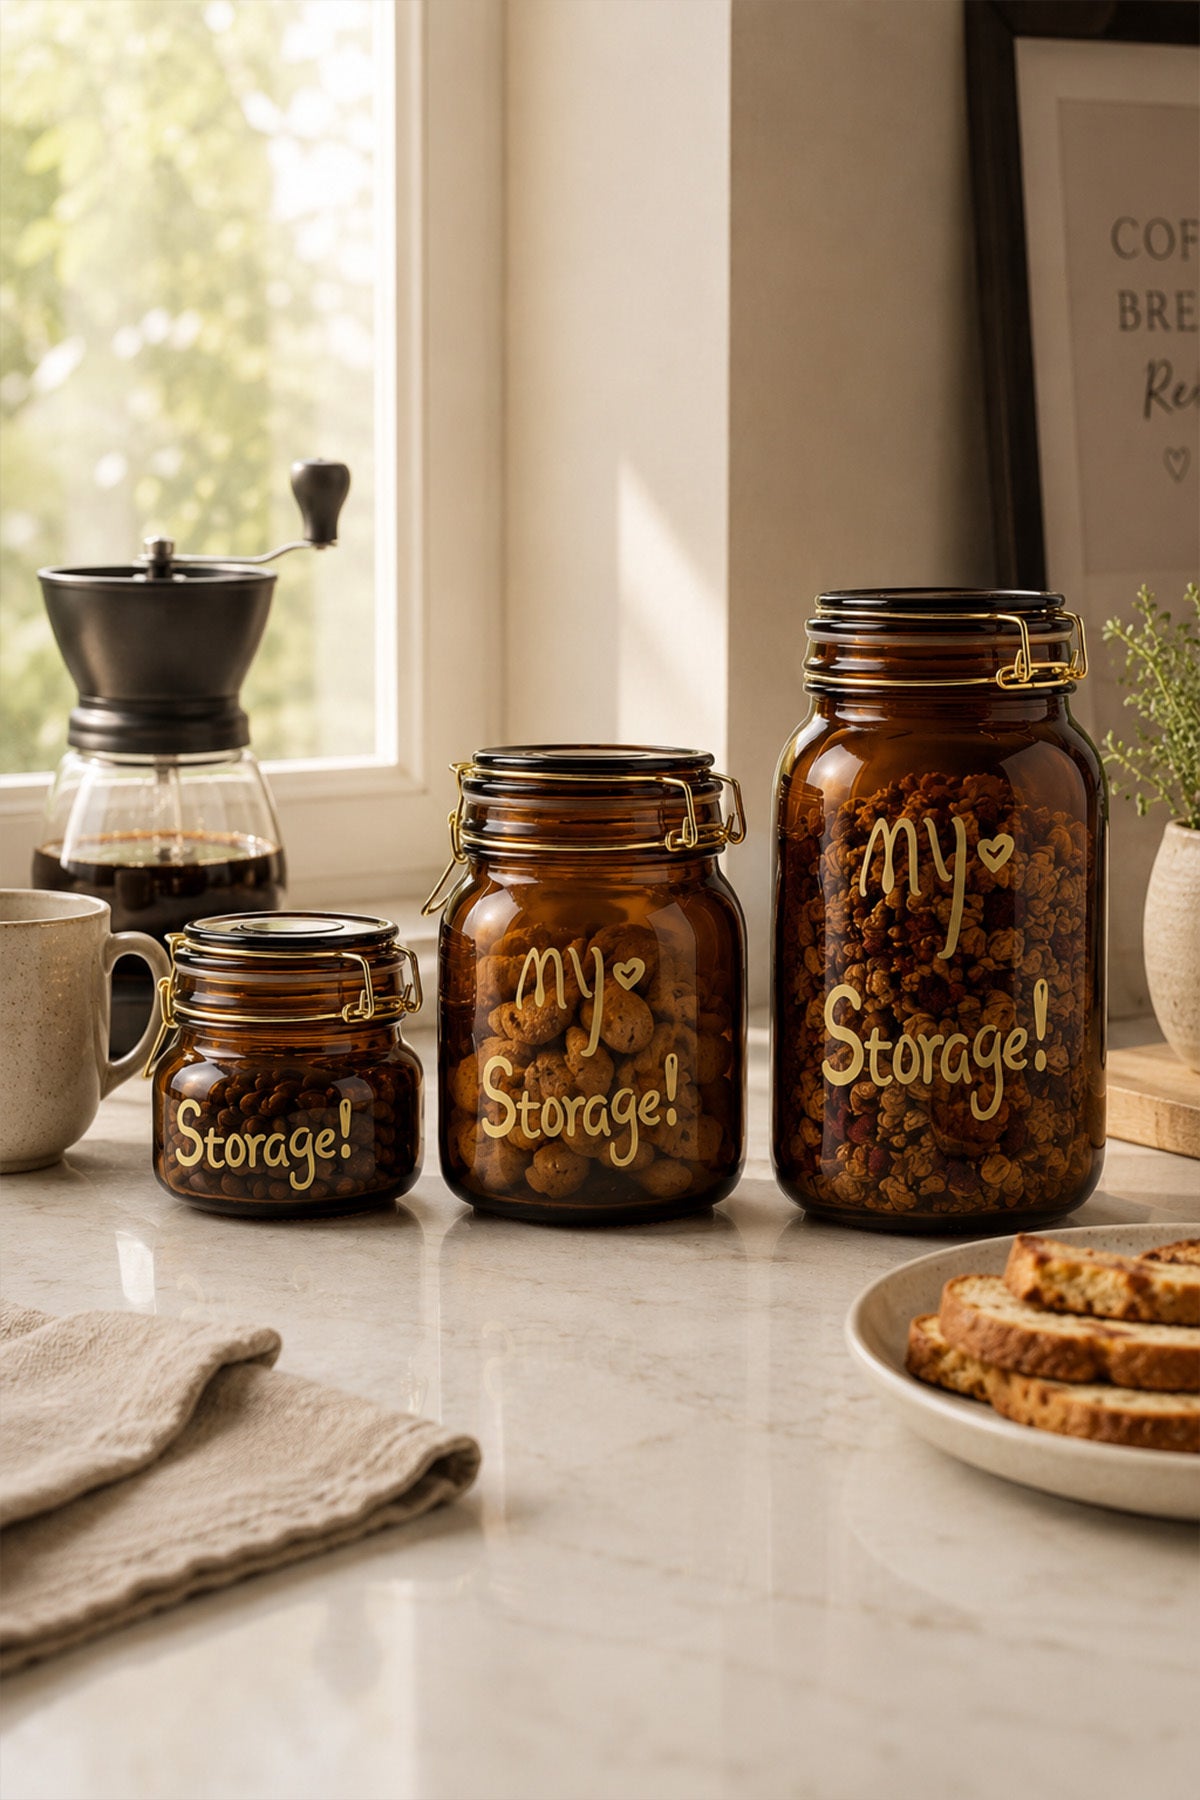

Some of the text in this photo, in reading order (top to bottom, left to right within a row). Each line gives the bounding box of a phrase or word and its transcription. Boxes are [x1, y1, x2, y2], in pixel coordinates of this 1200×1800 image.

[1110, 216, 1200, 262] COF
[1118, 289, 1199, 332] BRE
[822, 978, 1049, 1121] Storage!
[175, 1098, 352, 1190] Storage!
[481, 1053, 678, 1167] Storage!
